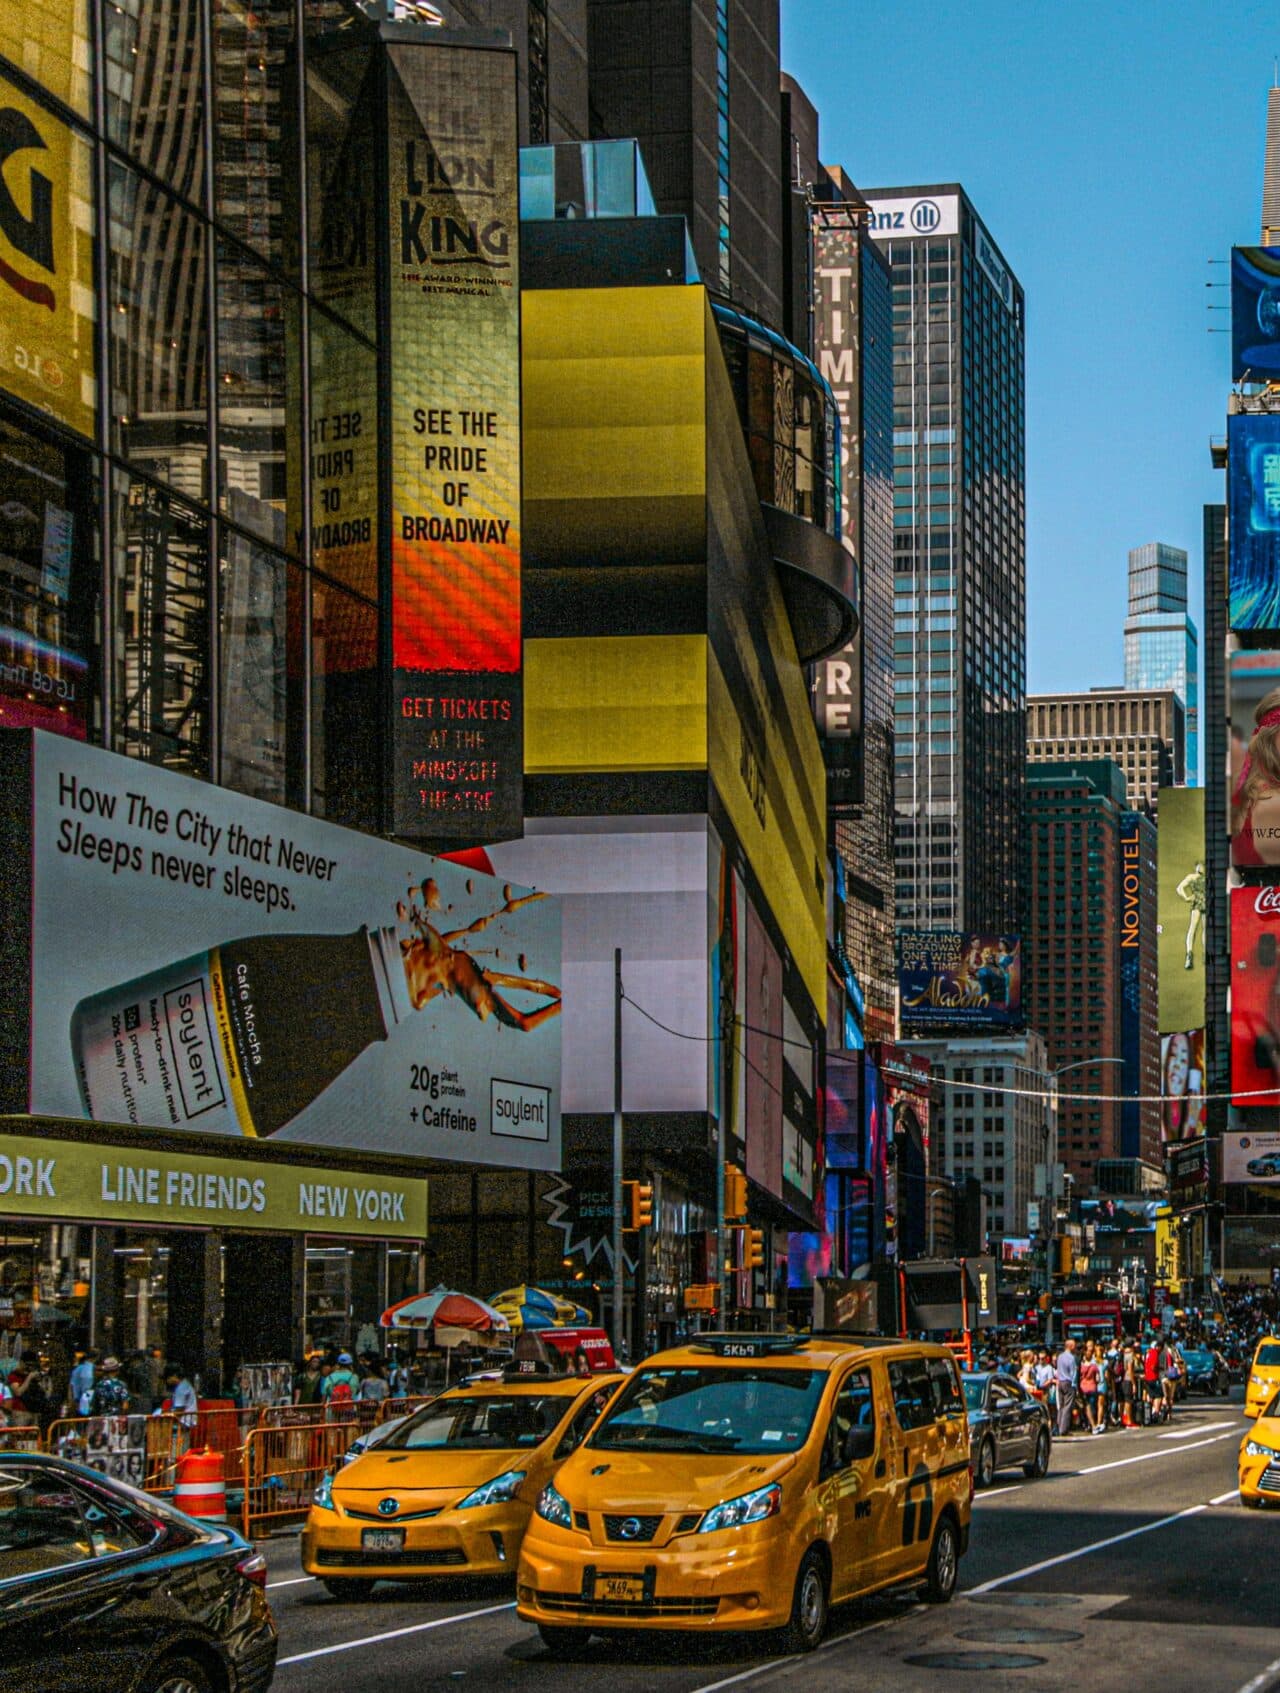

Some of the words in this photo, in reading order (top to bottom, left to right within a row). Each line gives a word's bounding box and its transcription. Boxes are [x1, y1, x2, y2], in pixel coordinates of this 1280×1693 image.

[406, 141, 495, 196] LION
[401, 200, 510, 265] KING
[413, 408, 452, 435] SEE
[458, 410, 498, 438] THE
[424, 445, 487, 473] PRIDE
[442, 481, 469, 507] OF
[401, 515, 510, 545] BROADWAY
[402, 696, 433, 719] GET
[440, 698, 512, 721] TICKETS
[428, 729, 448, 749] AT
[456, 730, 485, 750] THE
[57, 771, 116, 820] How
[126, 791, 169, 834] The
[175, 808, 222, 856] City
[227, 824, 273, 865] that
[276, 838, 338, 881] Never
[56, 818, 143, 875] Sleeps
[151, 850, 217, 889] never
[223, 865, 297, 913] sleeps.
[1120, 828, 1141, 948] NOVOTEL
[901, 933, 962, 945] DAZZLING
[901, 942, 962, 952] BROADWAY
[901, 951, 927, 961] ONE
[930, 951, 962, 962] WISH
[902, 961, 916, 971] AT
[919, 962, 929, 971] A
[902, 975, 990, 1009] Aladdin
[178, 993, 214, 1101] soylent
[243, 1004, 262, 1065] Mocha
[114, 1038, 126, 1069] daily
[410, 1063, 440, 1100] 20g
[440, 1084, 466, 1098] protein
[422, 1104, 477, 1133] Caffeine
[496, 1095, 545, 1126] soylent
[101, 1164, 160, 1204] LINE
[165, 1170, 267, 1213] FRIENDS
[300, 1182, 349, 1220] NEW
[352, 1187, 406, 1223] YORK
